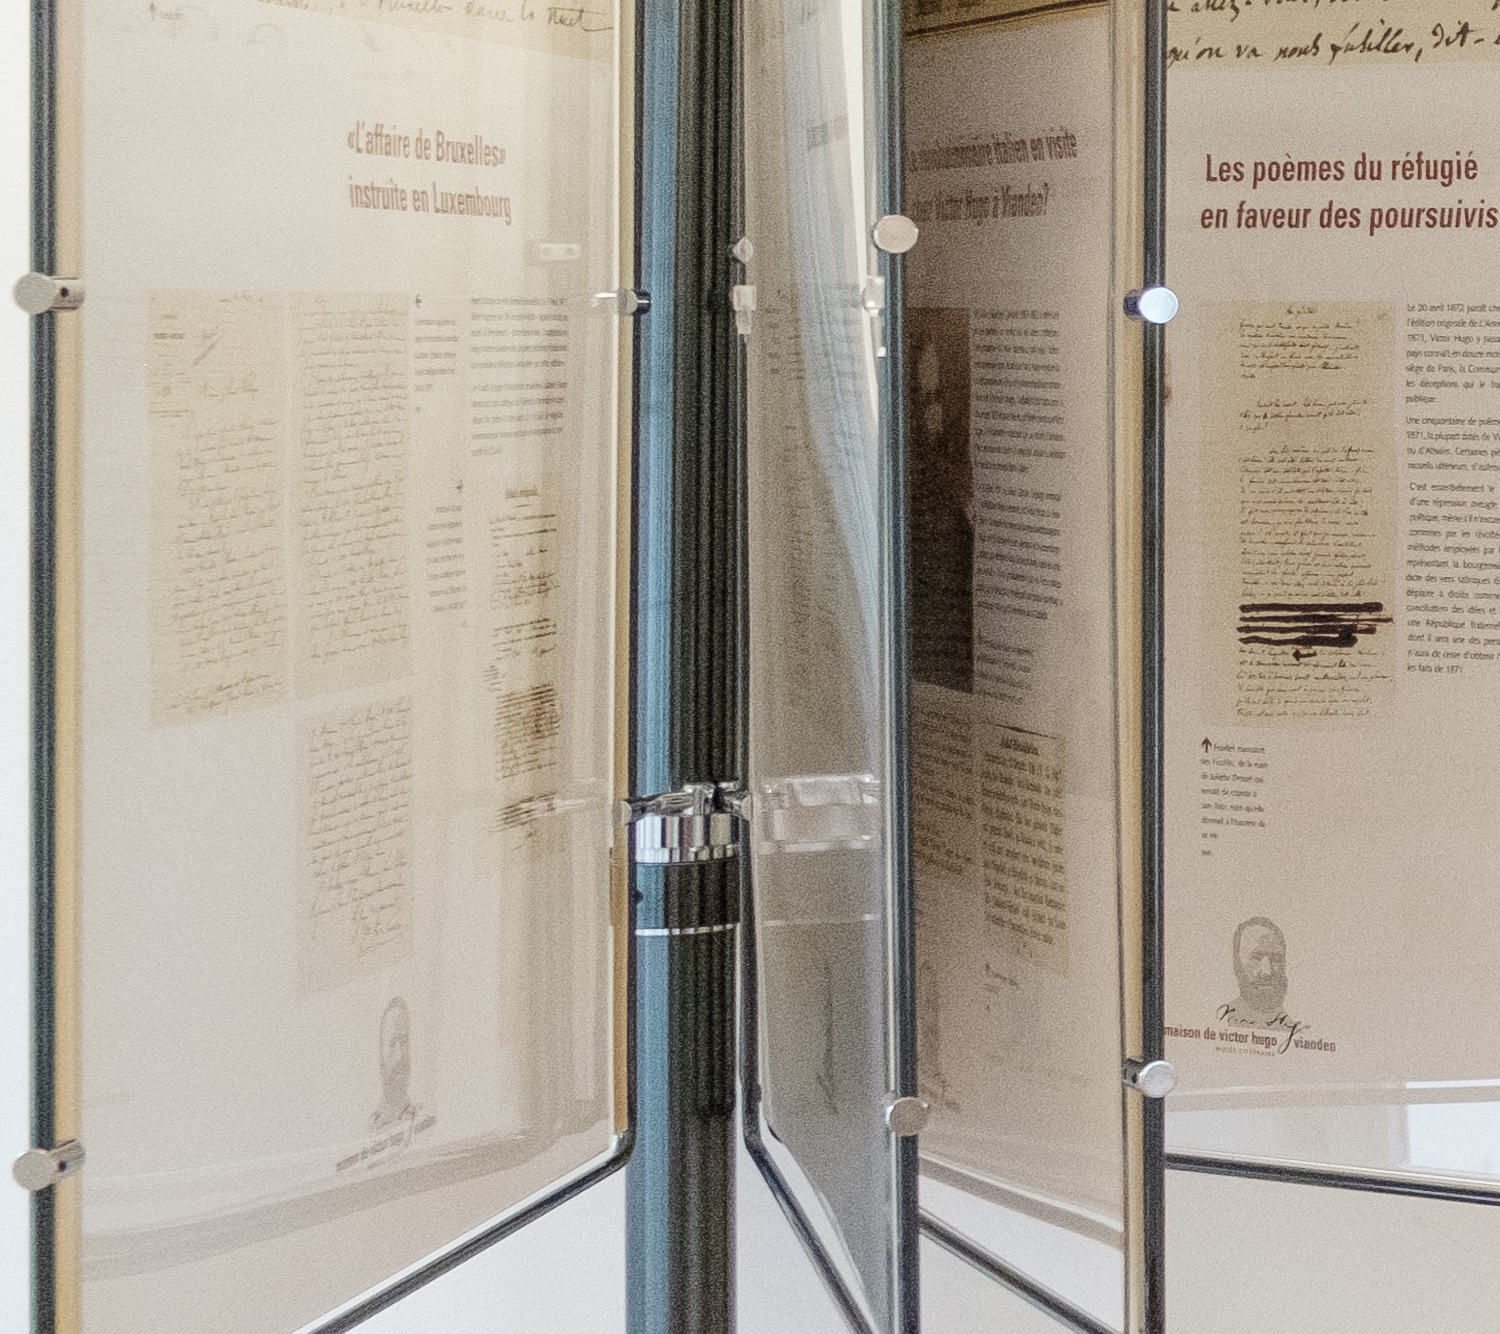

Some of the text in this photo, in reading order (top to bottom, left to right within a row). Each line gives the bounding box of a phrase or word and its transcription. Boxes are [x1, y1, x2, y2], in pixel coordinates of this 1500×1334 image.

[347, 120, 506, 167] «L'affaire de Bruxelles»
[1205, 151, 1479, 189] Les poèmes du réfugié
[349, 175, 511, 226] instruite en Luxembourg
[1200, 199, 1500, 237] en faveur des poursuivis
[1164, 1025, 1337, 1053] maison de victor hugo vianden
